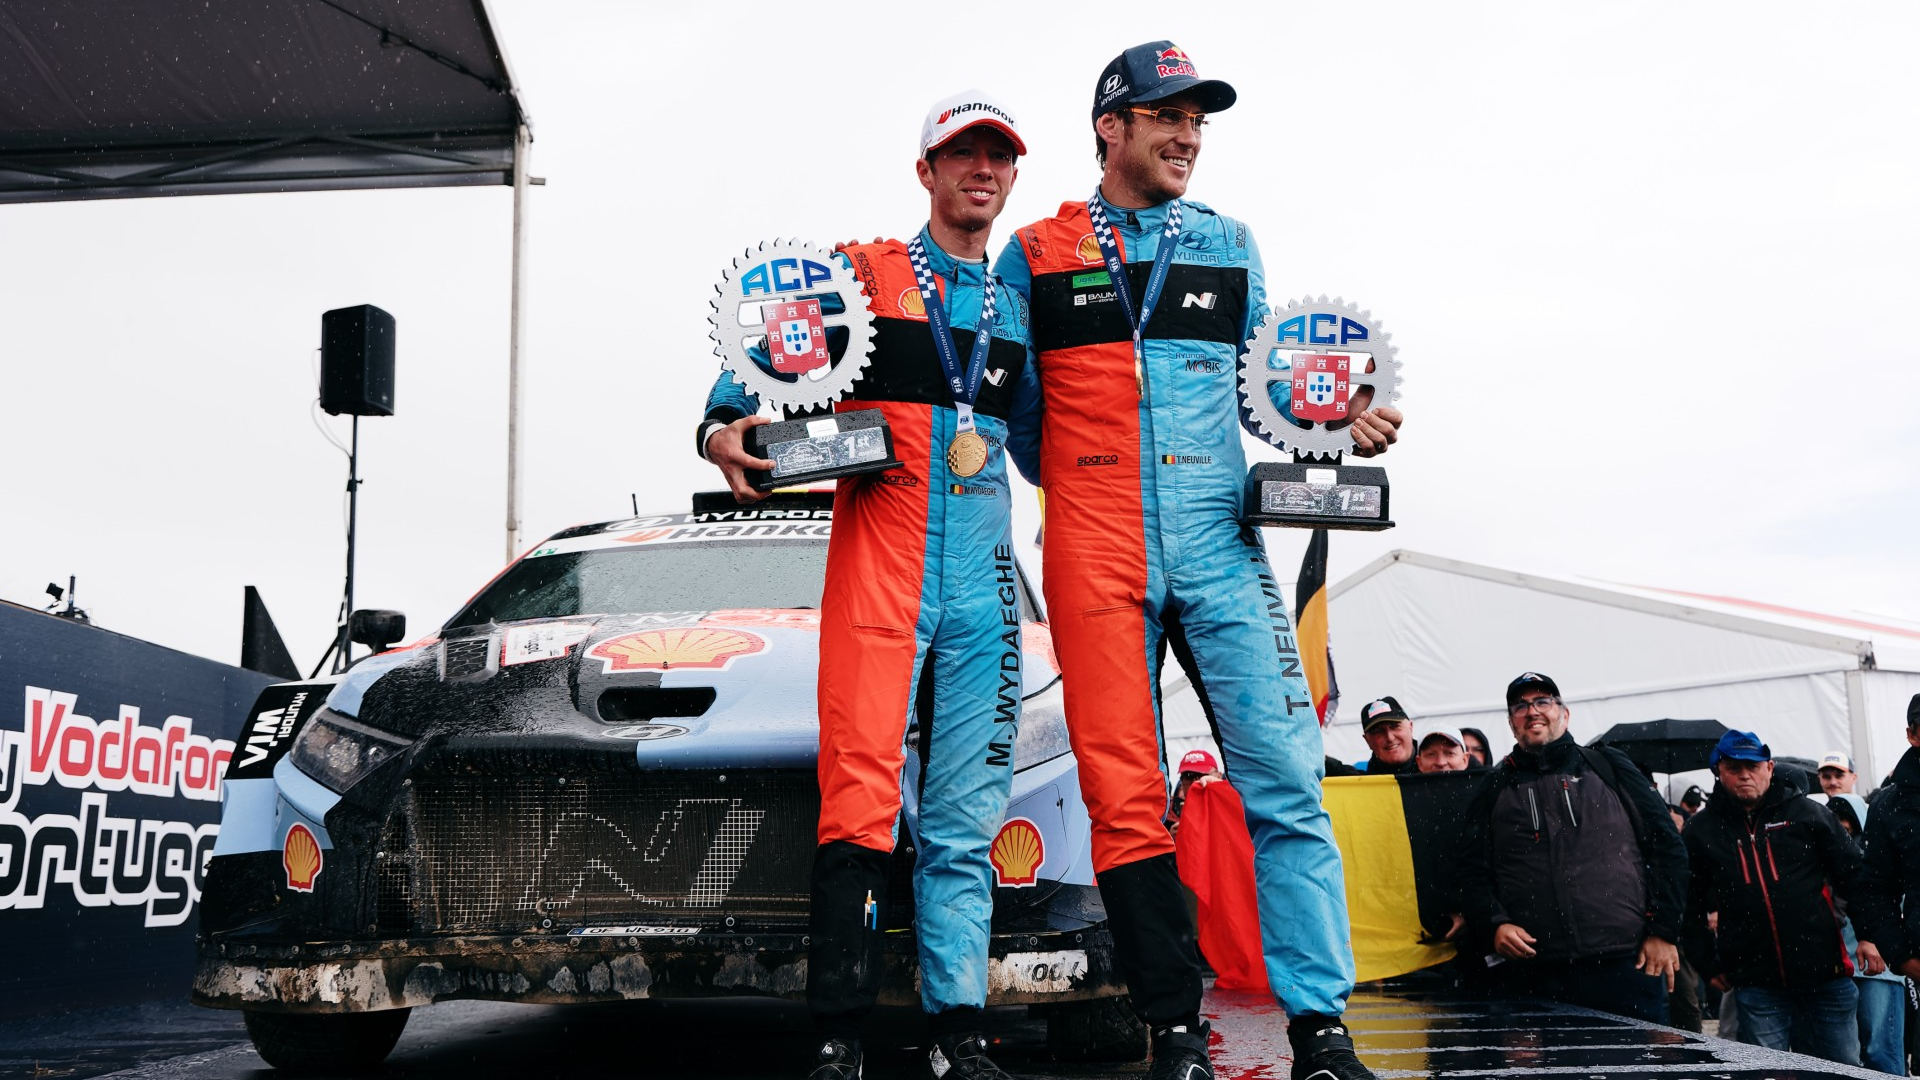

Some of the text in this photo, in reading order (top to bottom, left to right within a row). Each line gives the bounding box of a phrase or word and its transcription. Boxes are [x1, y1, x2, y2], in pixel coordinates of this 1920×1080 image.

[1156, 64, 1185, 79] Red
[1100, 84, 1130, 108] HYUNDAI
[1111, 257, 1120, 272] FIA
[741, 258, 833, 297] ACP
[854, 251, 880, 298] sparco
[1087, 291, 1118, 301] BAUM
[979, 329, 989, 344] FIA
[1276, 313, 1370, 346] ACP
[1185, 359, 1222, 374] MOBIS
[952, 377, 964, 394] FIA
[959, 415, 970, 424] FIA
[979, 434, 1001, 448] OBIS
[1076, 454, 1119, 467] sparco
[1176, 455, 1212, 465] T.NEUVILLE
[881, 475, 919, 487] parco
[1339, 488, 1366, 511] 1st
[683, 509, 834, 524] HYUNDA
[992, 543, 1020, 724] WYDAEGHE
[1284, 690, 1310, 716] T.
[276, 692, 309, 738] HYUNDAI
[29, 699, 234, 791] Vodafon
